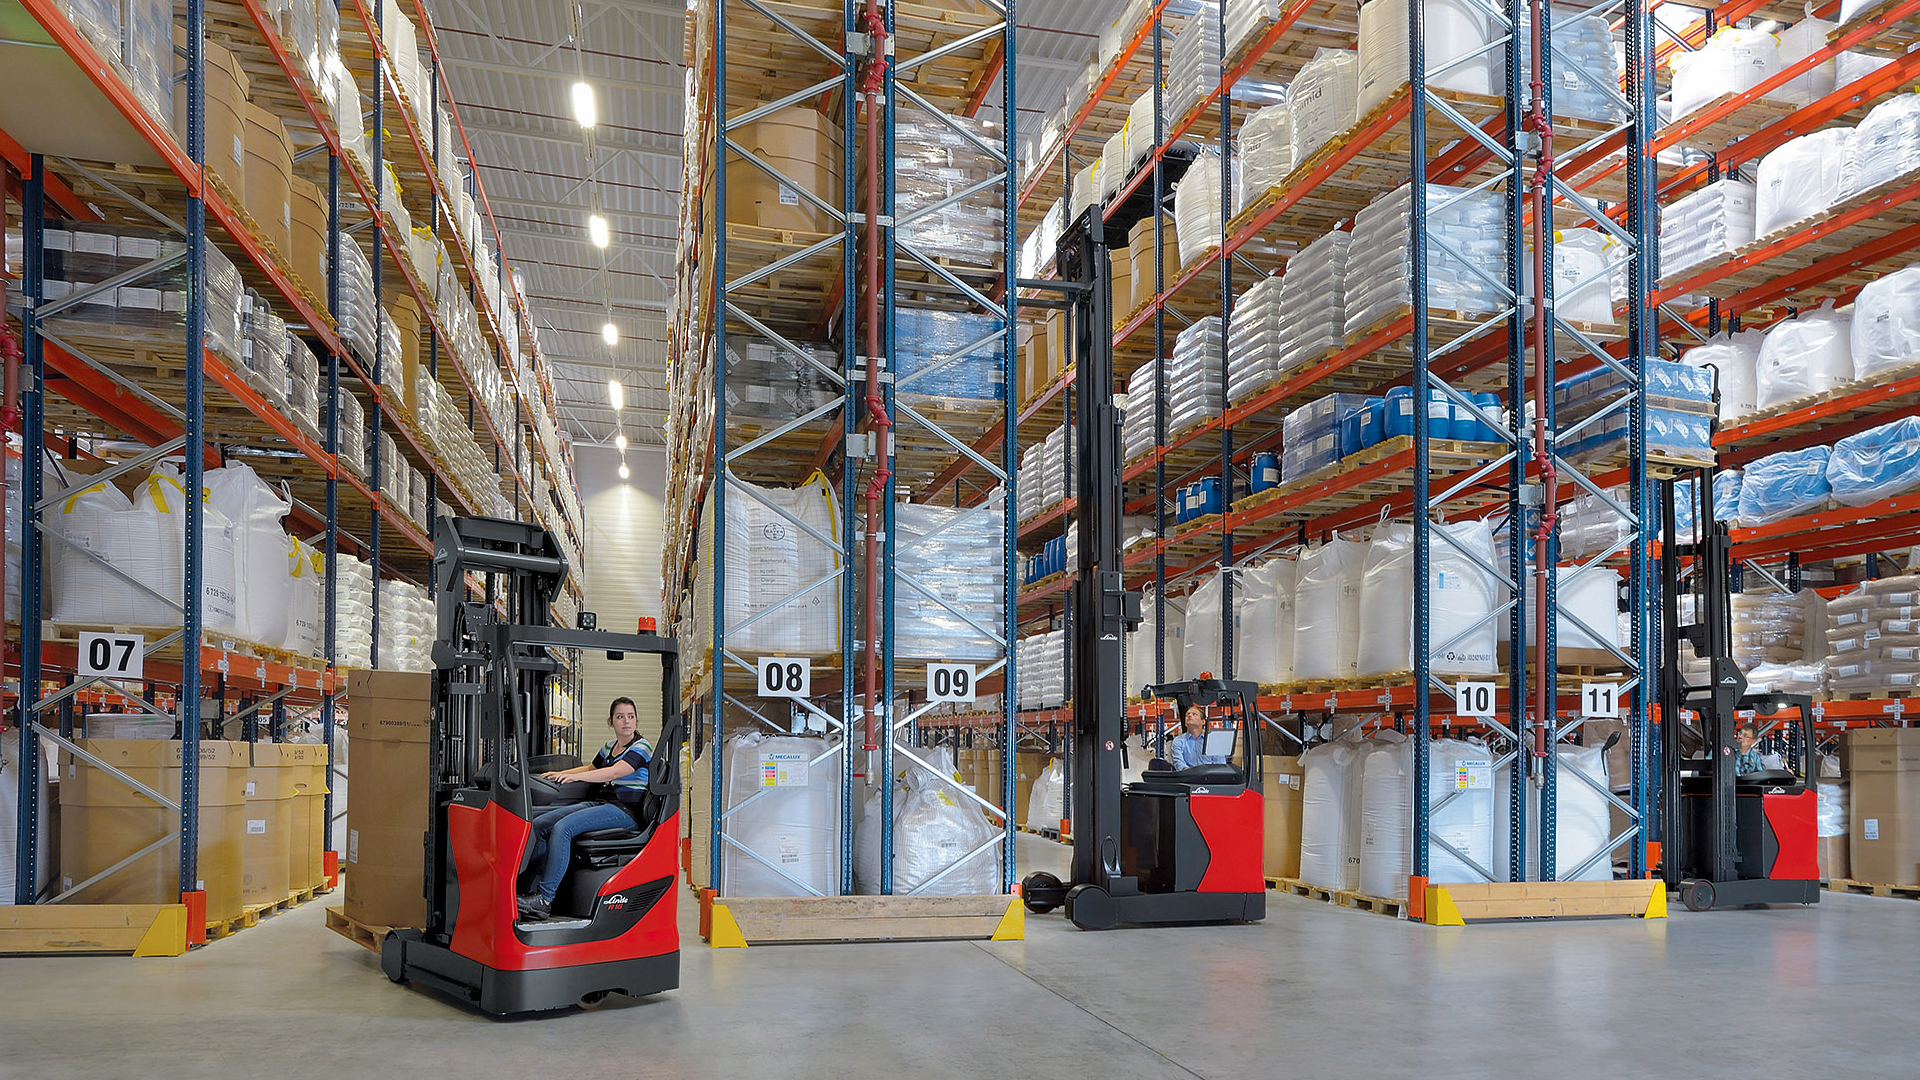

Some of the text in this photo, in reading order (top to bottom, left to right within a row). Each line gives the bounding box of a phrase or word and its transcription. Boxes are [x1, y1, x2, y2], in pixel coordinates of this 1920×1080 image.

[89, 638, 136, 671] 07
[766, 662, 803, 692] 08
[934, 668, 969, 697] 09
[1461, 687, 1489, 712] 10
[1588, 688, 1611, 713] 11
[603, 894, 629, 905] Linde
